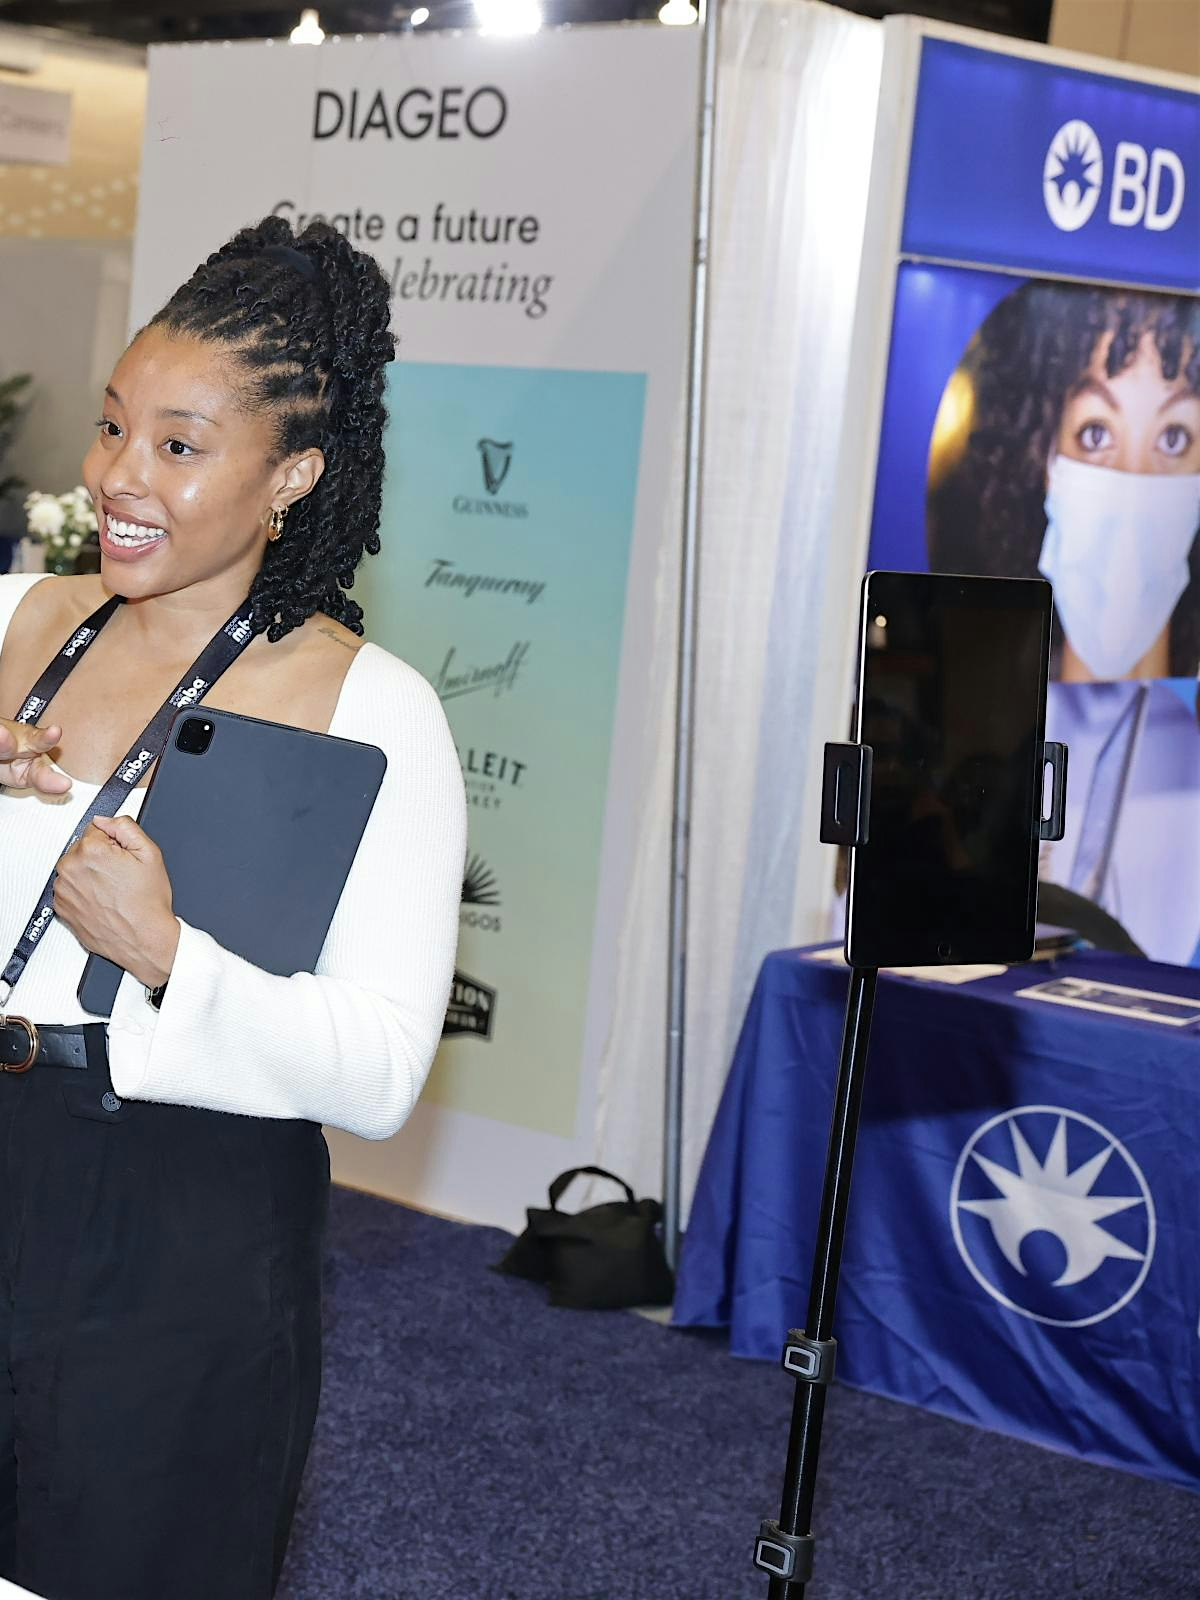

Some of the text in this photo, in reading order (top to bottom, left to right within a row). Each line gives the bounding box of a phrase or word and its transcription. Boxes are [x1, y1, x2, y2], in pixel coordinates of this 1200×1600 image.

[312, 85, 508, 141] DIAGEO
[1108, 141, 1185, 232] BD
[396, 214, 419, 242] a
[431, 202, 540, 244] future
[390, 257, 554, 319] lebrating
[452, 496, 530, 519] GUINNESS
[425, 558, 547, 605] Tanqueray
[65, 627, 91, 657] mba
[122, 750, 150, 783] mba
[462, 748, 528, 786] LEIT
[29, 906, 52, 942] mba
